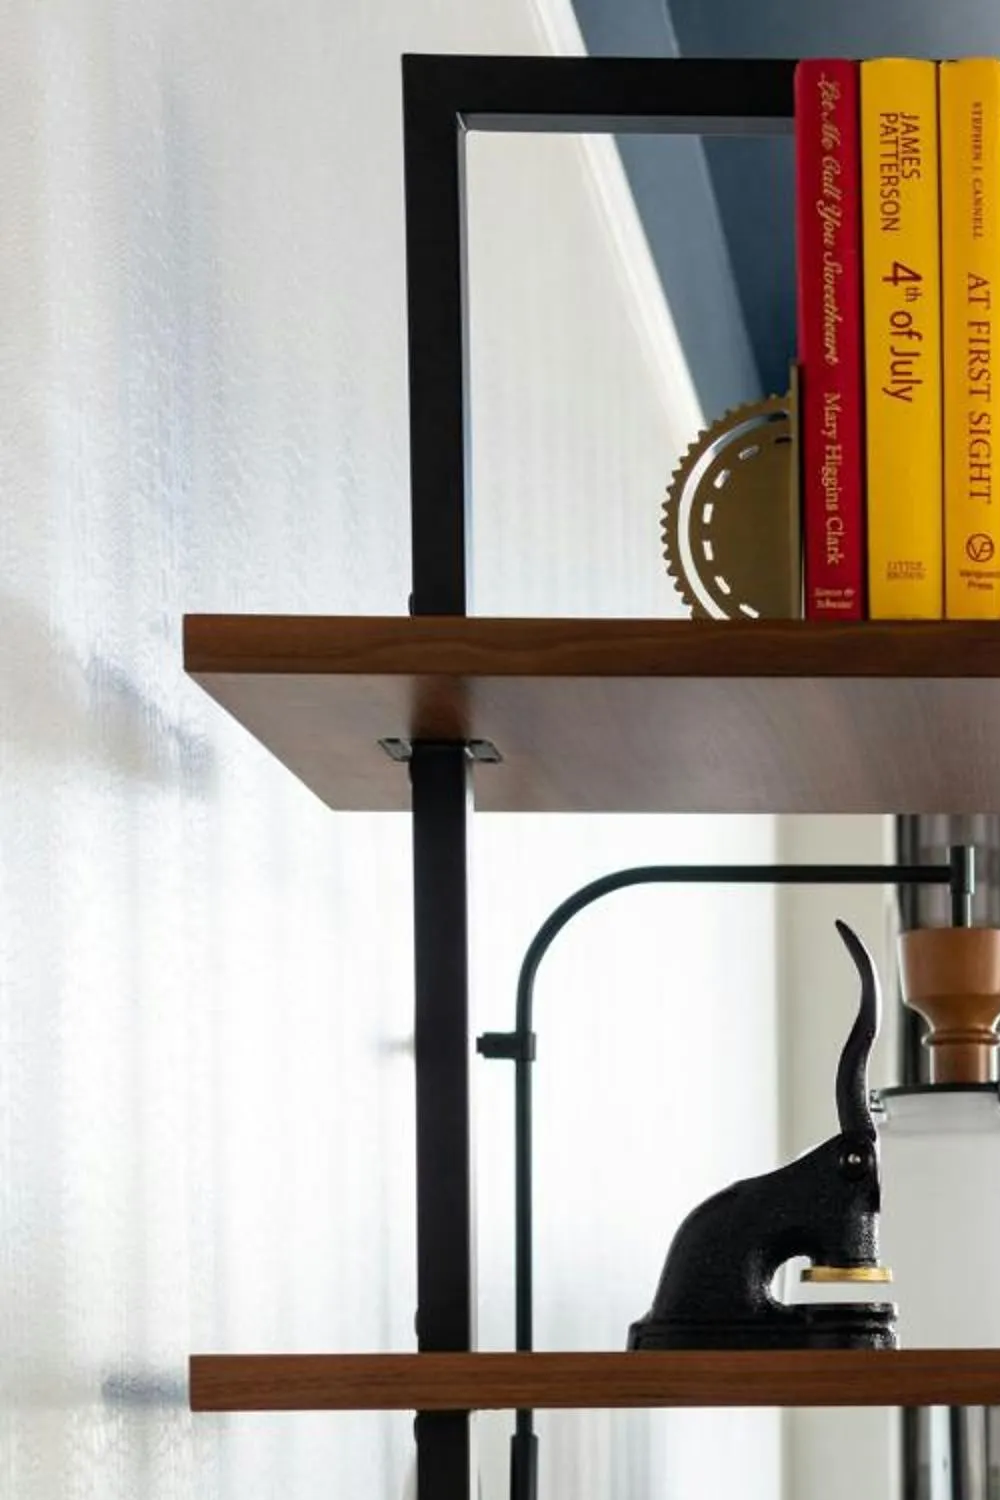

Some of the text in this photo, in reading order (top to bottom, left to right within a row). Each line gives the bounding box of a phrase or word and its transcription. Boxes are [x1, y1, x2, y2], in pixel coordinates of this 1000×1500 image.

[879, 112, 900, 233] PATTERSON
[900, 111, 921, 181] JAMES
[816, 72, 844, 365] Let Me Call You Sweetheart
[881, 346, 923, 402] July
[889, 310, 923, 340] of
[967, 271, 993, 504] AT FIRST SIGHT
[821, 392, 845, 565] Mary Higgins Clark
